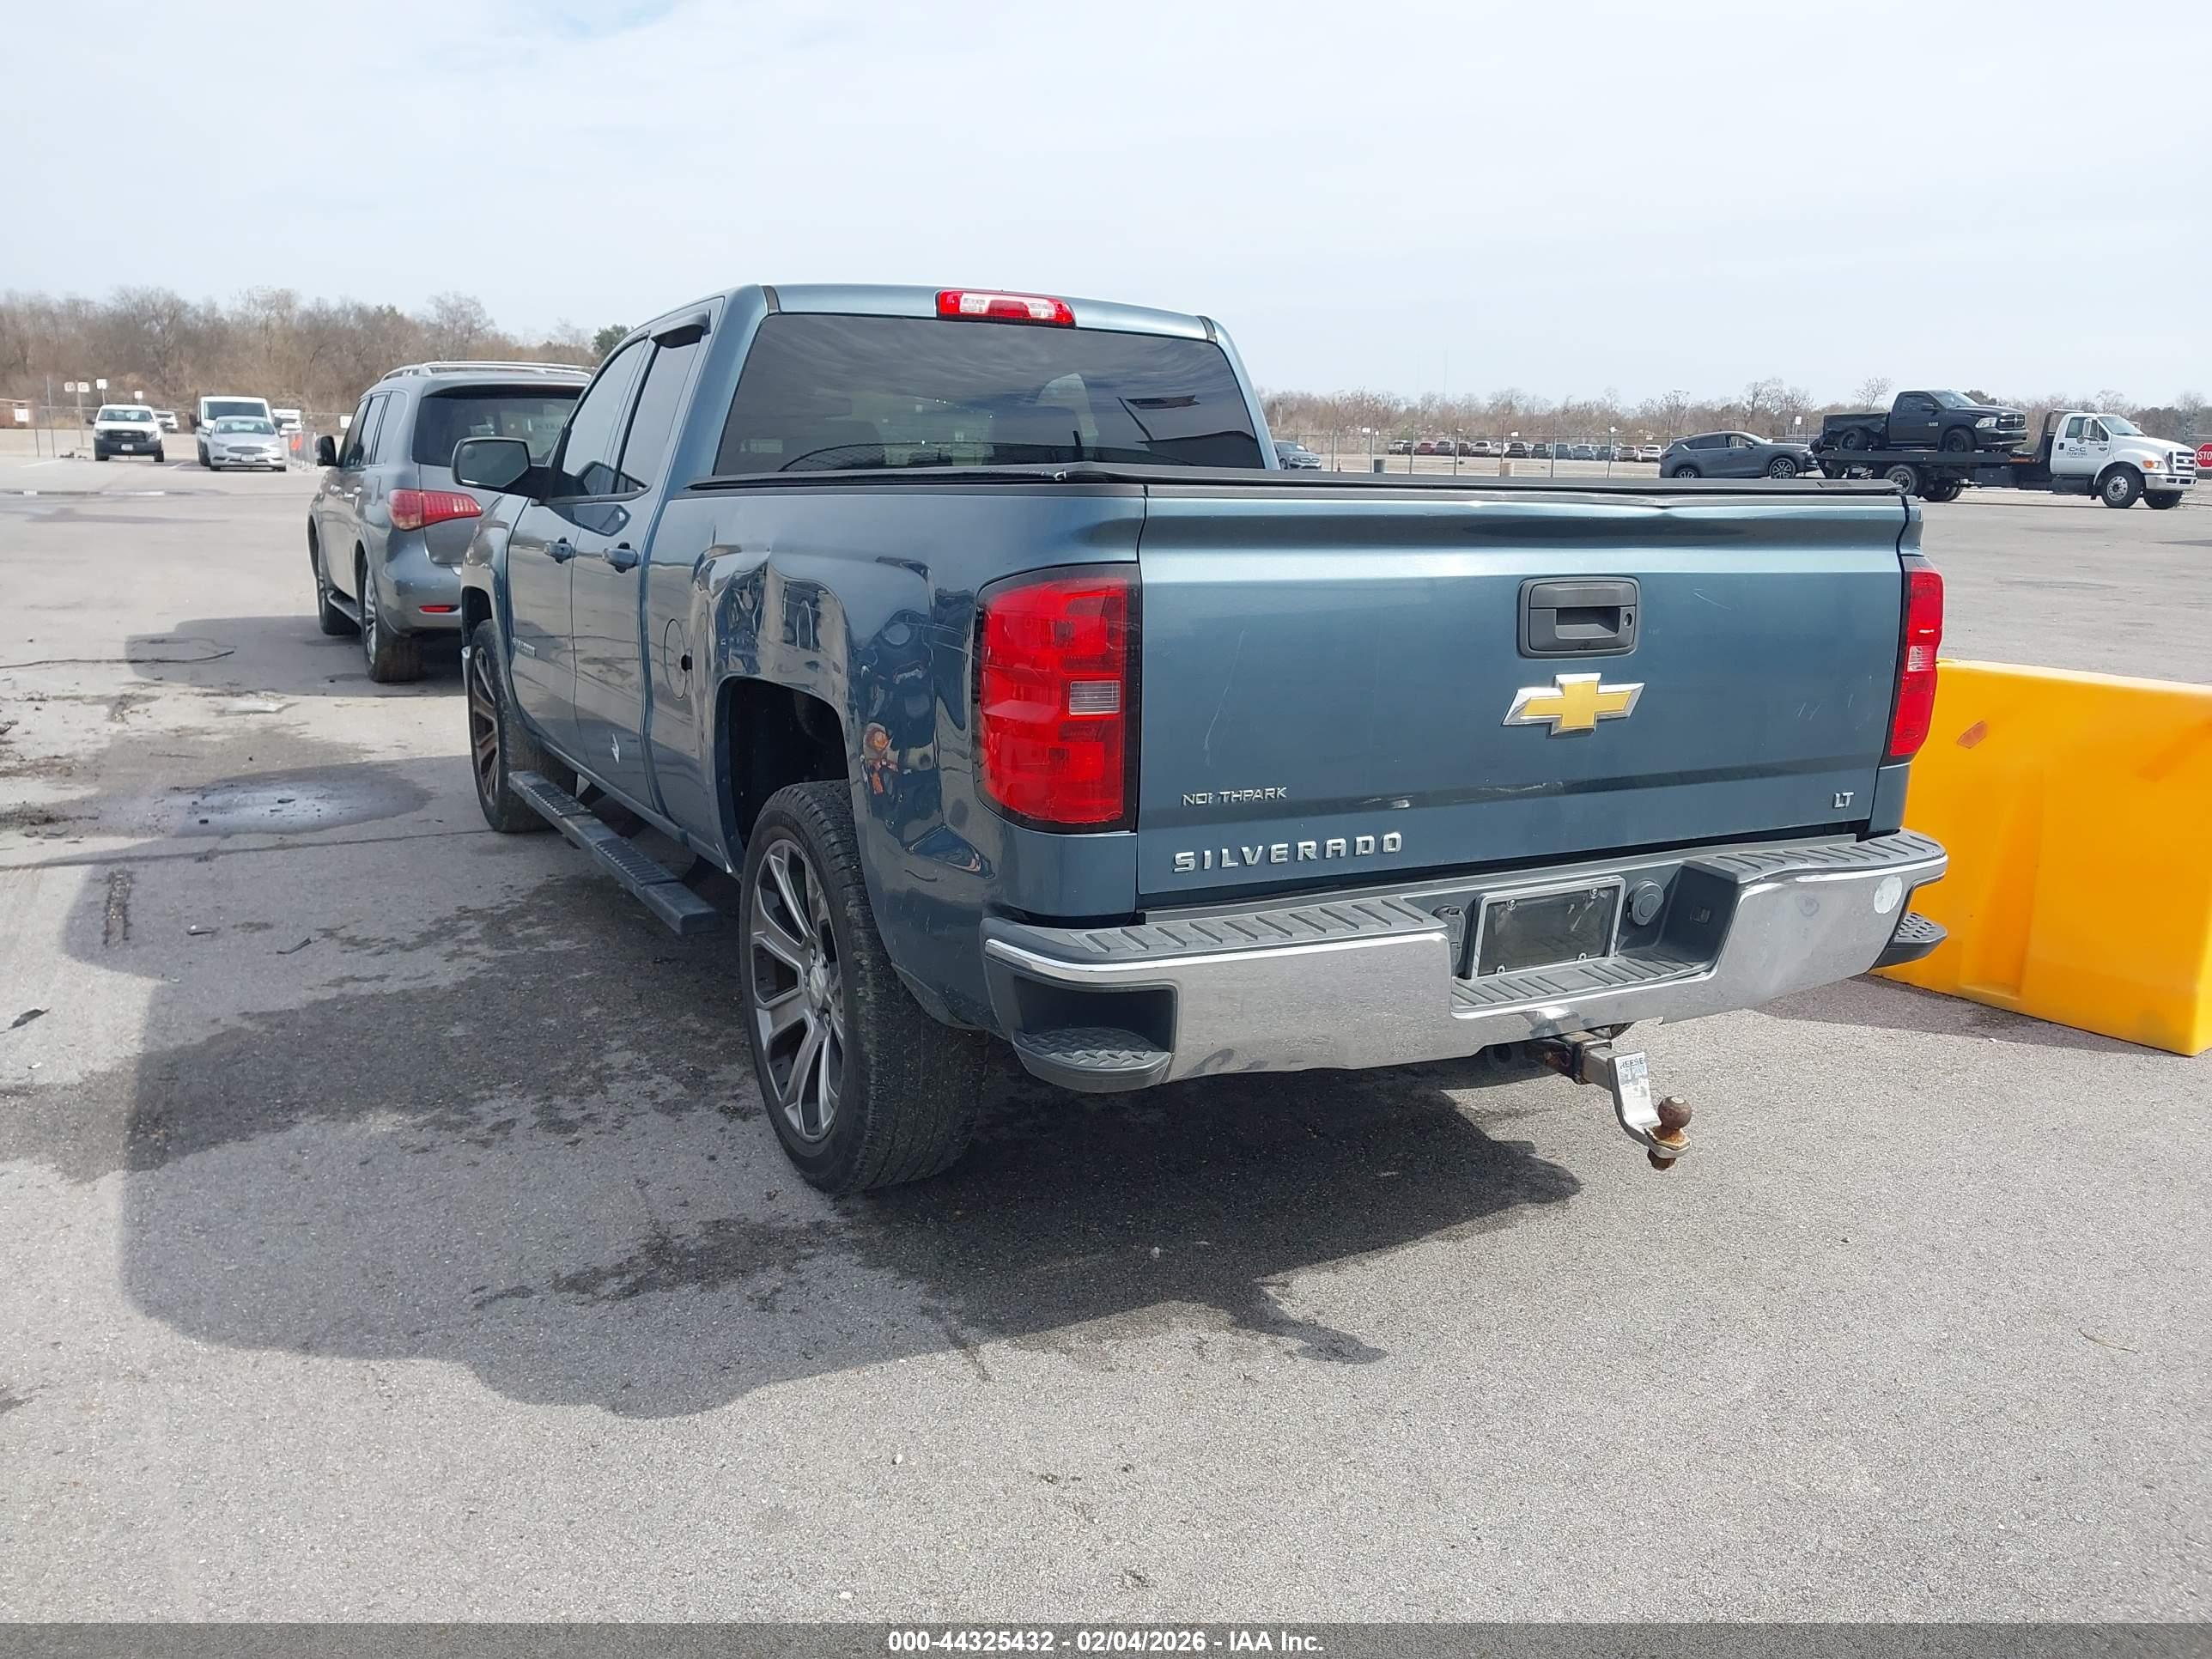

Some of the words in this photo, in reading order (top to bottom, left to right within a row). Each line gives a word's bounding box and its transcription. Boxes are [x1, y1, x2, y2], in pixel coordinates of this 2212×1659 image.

[2197, 451, 2212, 461] STO
[1833, 791, 1855, 808] LT
[1173, 831, 1403, 872] SILVERADO
